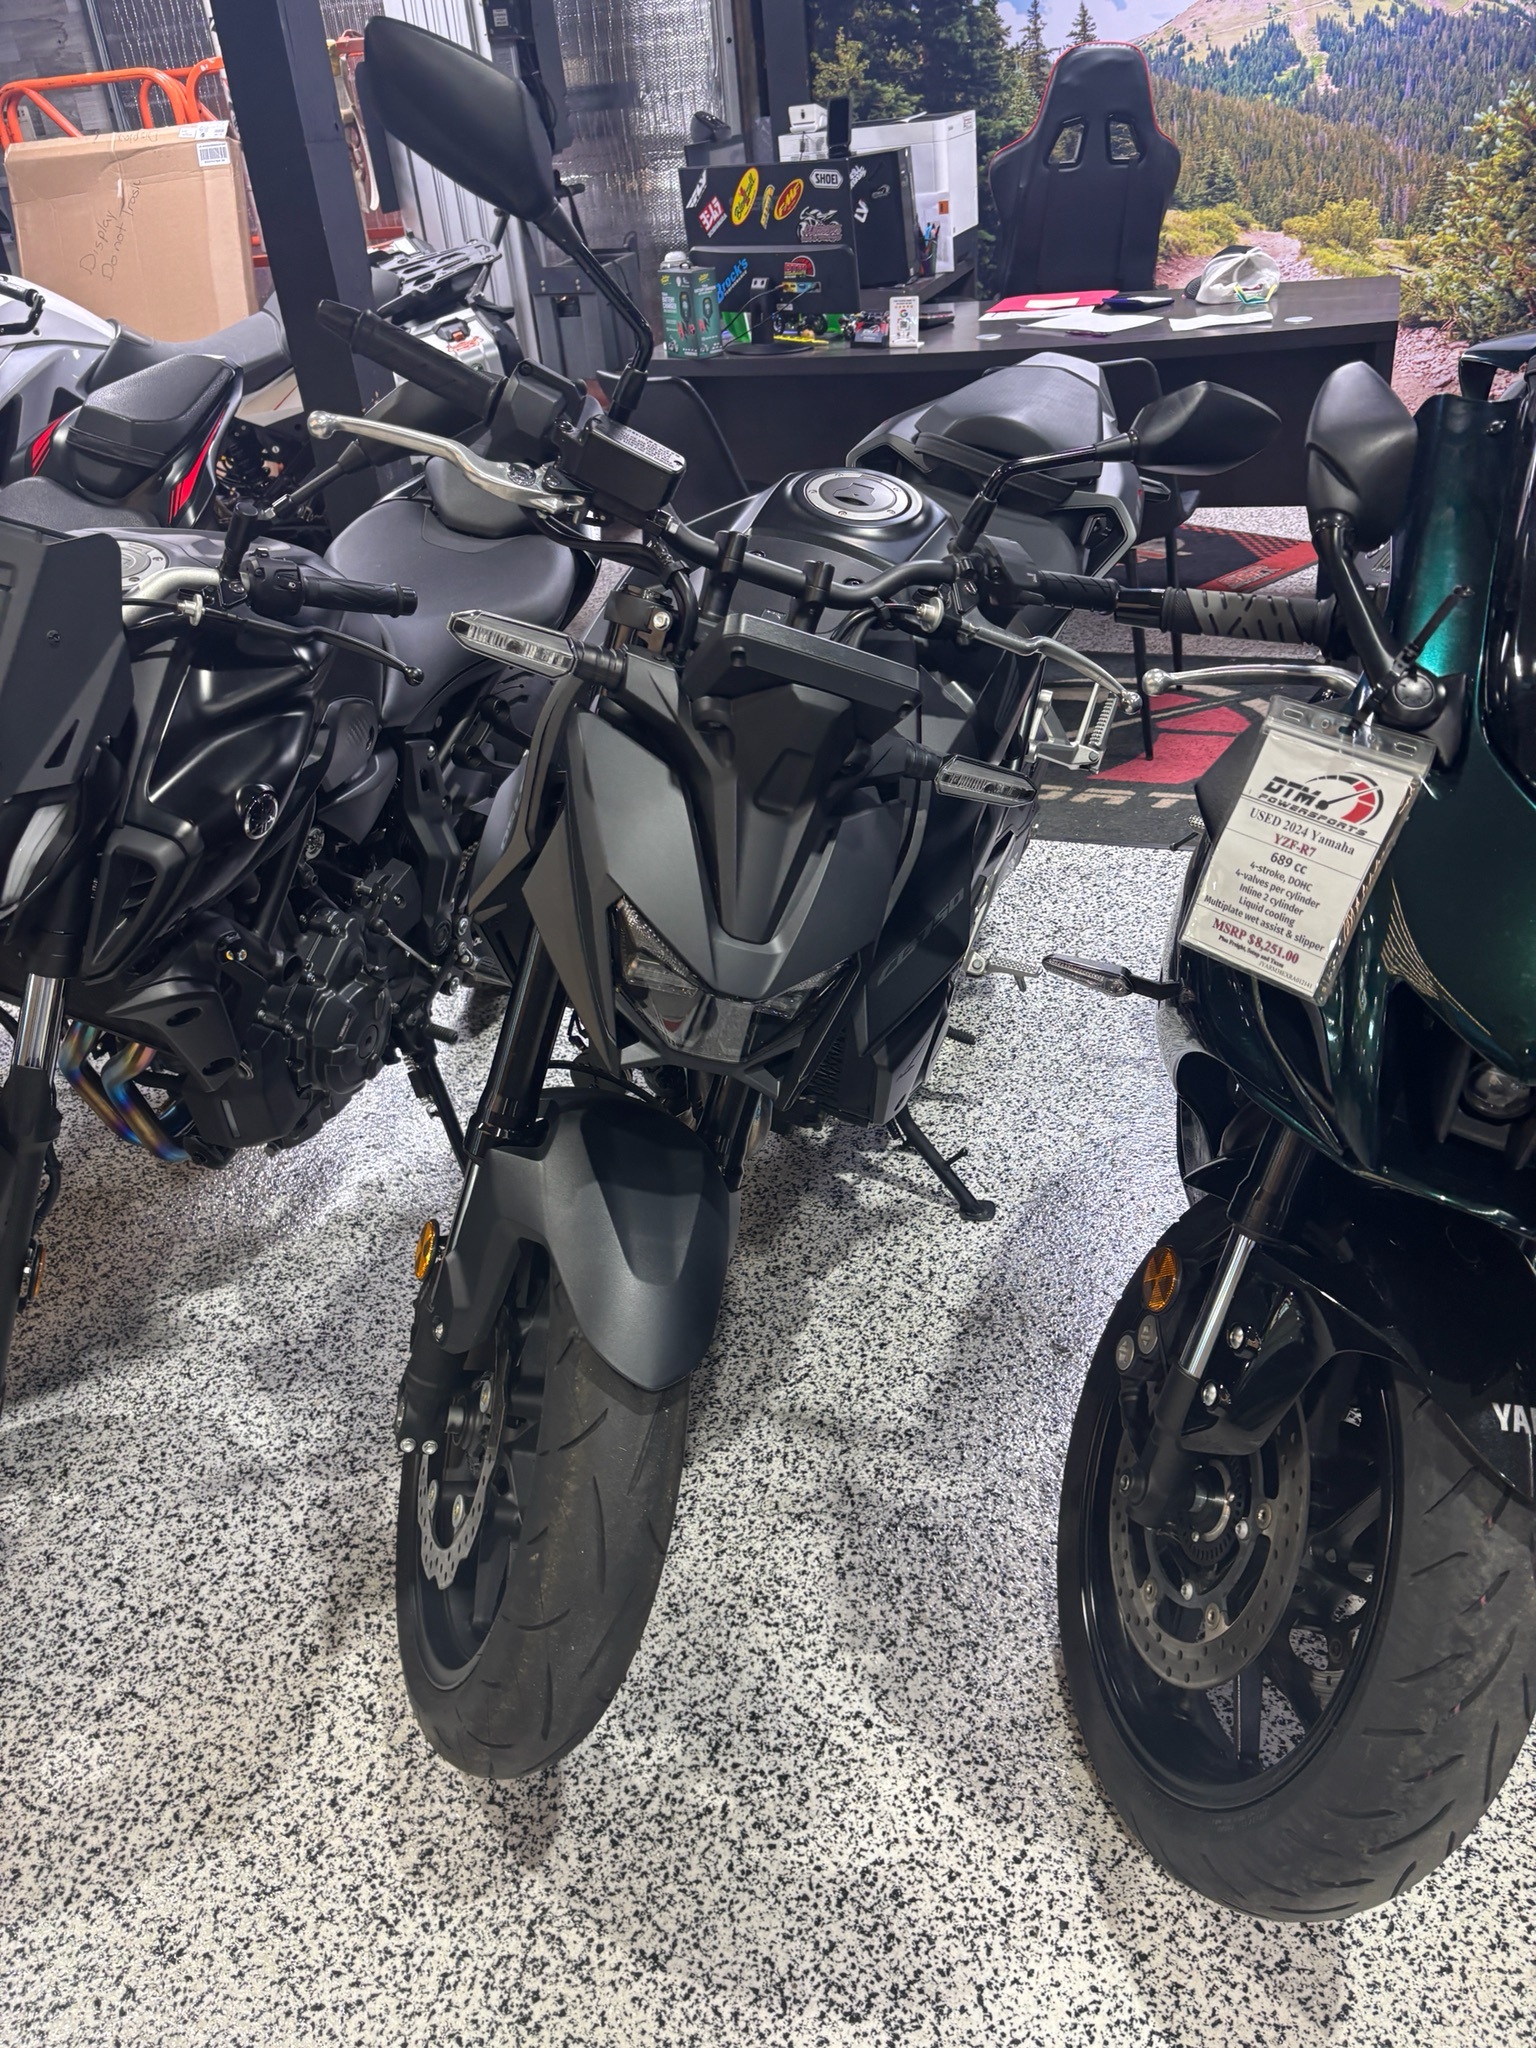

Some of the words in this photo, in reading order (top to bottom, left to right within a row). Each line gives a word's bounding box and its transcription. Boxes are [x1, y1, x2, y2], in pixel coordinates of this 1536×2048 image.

[815, 173, 839, 185] SHOEI
[80, 210, 117, 275] Display
[716, 258, 749, 304] Brock's
[1263, 776, 1322, 807] DTM
[1249, 807, 1282, 828] USED
[1282, 820, 1309, 837] 2024
[1310, 830, 1355, 856] Yamaha
[1258, 793, 1368, 837] POWERSPORTS
[1273, 833, 1317, 858] YZF-R7
[1249, 861, 1287, 883] 4-stroke,
[1287, 876, 1313, 892] DOHC
[1270, 852, 1293, 868] 689
[1294, 863, 1308, 875] cc
[1235, 868, 1270, 889] 4-valves
[1269, 884, 1285, 897] per
[1285, 889, 1321, 909] cylinder
[1239, 883, 1262, 900] Inline
[1262, 893, 1270, 902] 2
[1269, 896, 1304, 916] cylinder
[1203, 895, 1244, 918] Multiplate
[1244, 912, 1260, 925] wet
[1260, 919, 1285, 936] assist
[1285, 929, 1293, 939] &
[1294, 933, 1325, 953] slipper
[1238, 896, 1264, 913] Liquid
[1264, 907, 1296, 928] cooling
[1212, 918, 1247, 940] MSRP
[1247, 933, 1300, 964] $8,251.00
[1260, 953, 1271, 962] and
